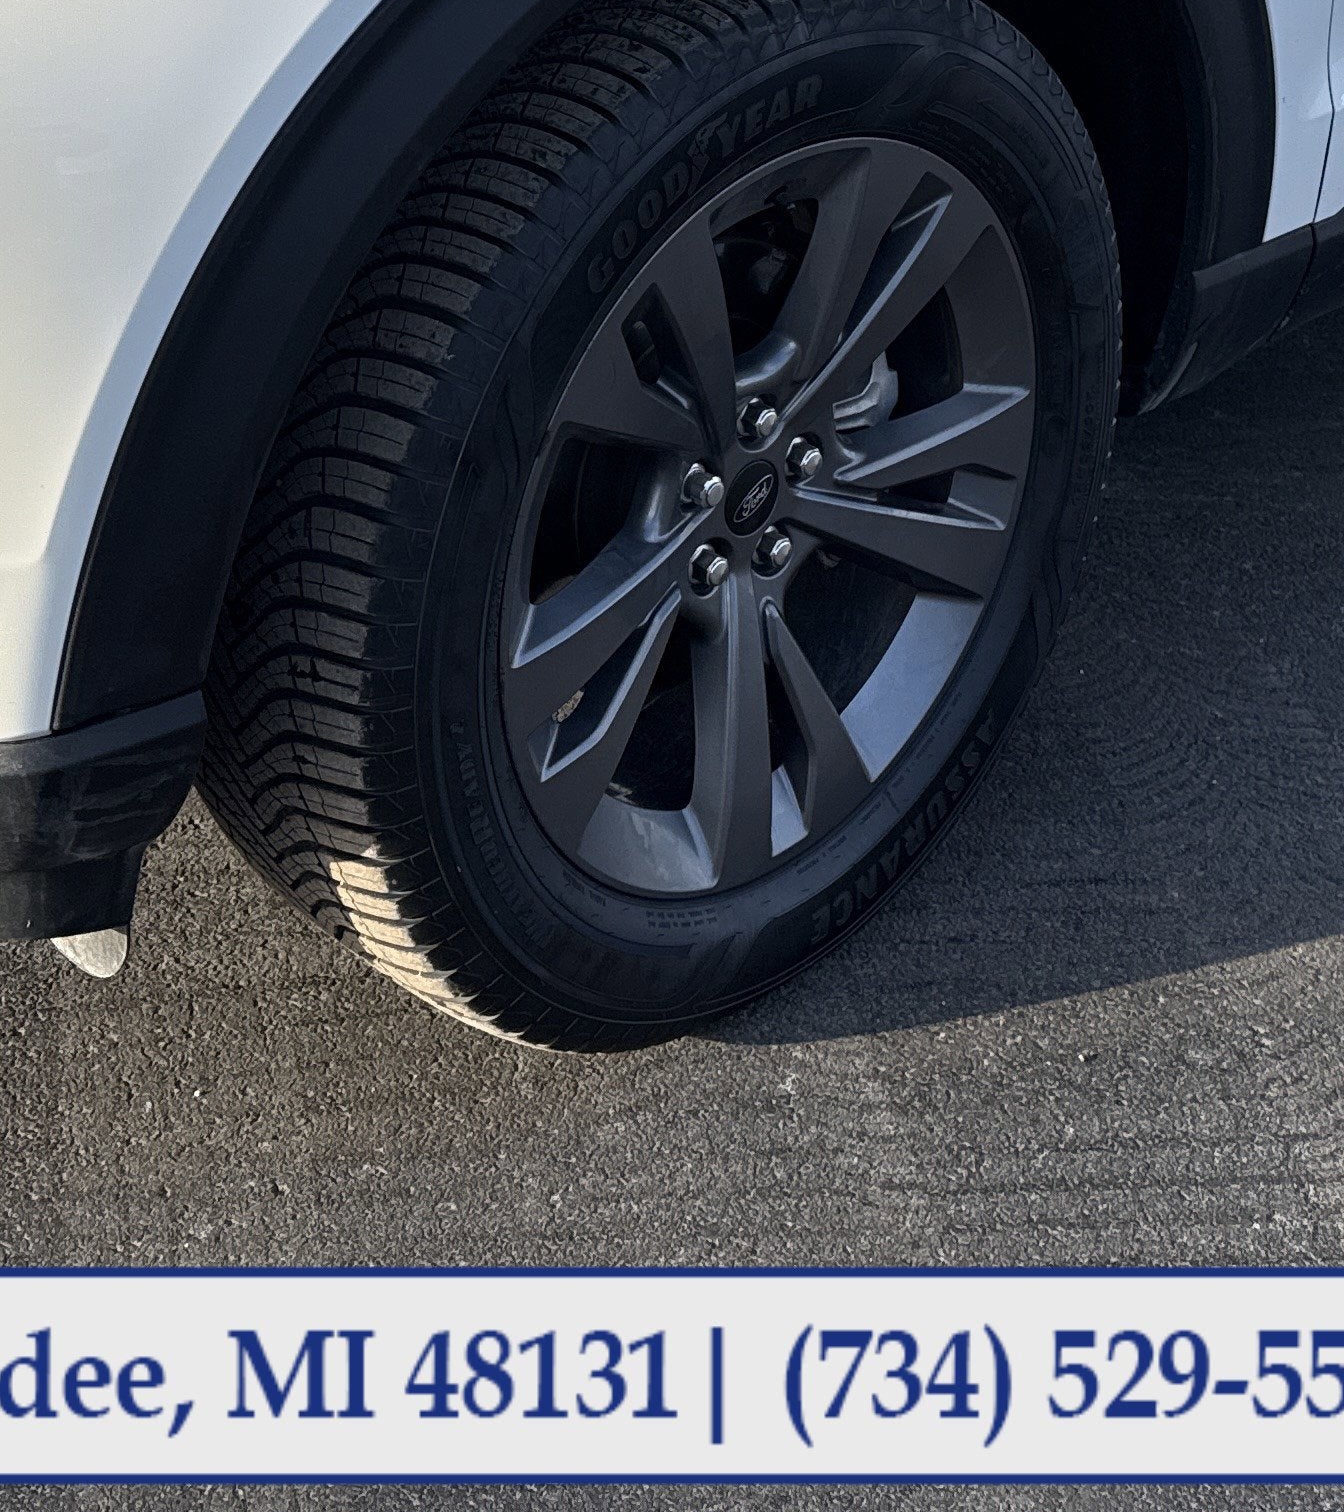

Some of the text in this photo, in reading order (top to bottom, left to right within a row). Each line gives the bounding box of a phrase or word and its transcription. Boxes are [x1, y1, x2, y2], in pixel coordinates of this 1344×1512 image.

[587, 73, 824, 294] GOODYEAR
[742, 481, 769, 517] Ford
[808, 707, 997, 944] ASSURANCE
